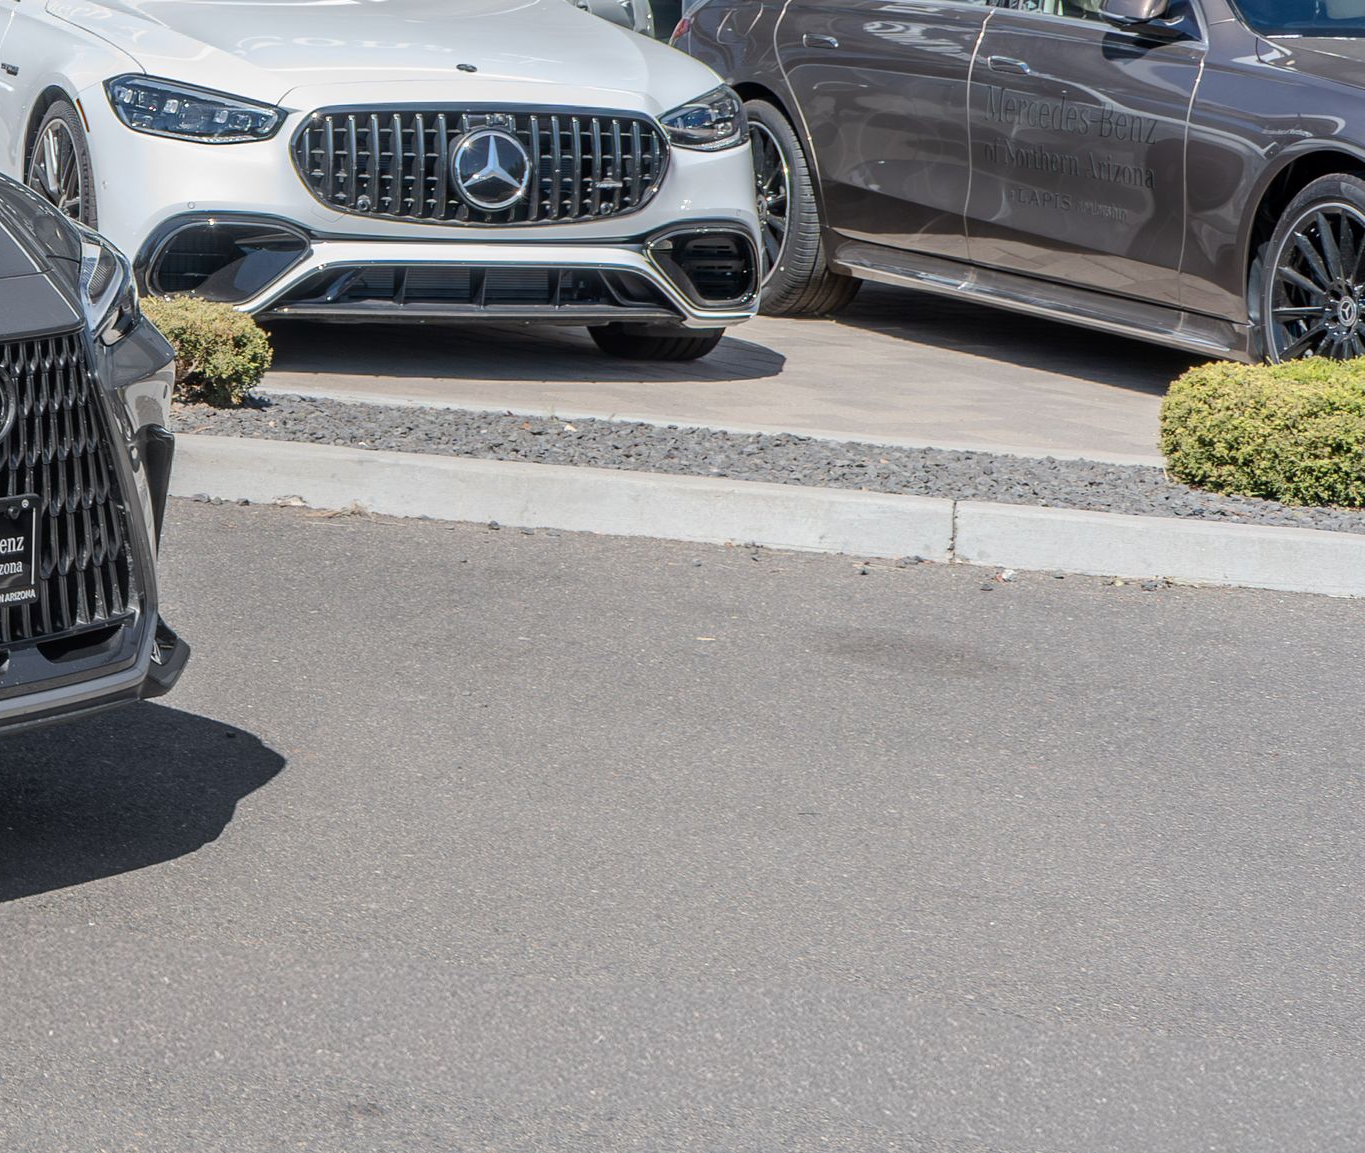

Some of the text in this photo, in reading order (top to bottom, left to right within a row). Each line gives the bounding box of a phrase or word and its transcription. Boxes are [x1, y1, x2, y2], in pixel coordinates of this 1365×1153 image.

[984, 85, 1158, 145] Mercedes-Benz
[984, 137, 1156, 189] of Northern Arizona
[1019, 188, 1072, 212] LAPIS
[4, 588, 36, 603] ARIZONA
